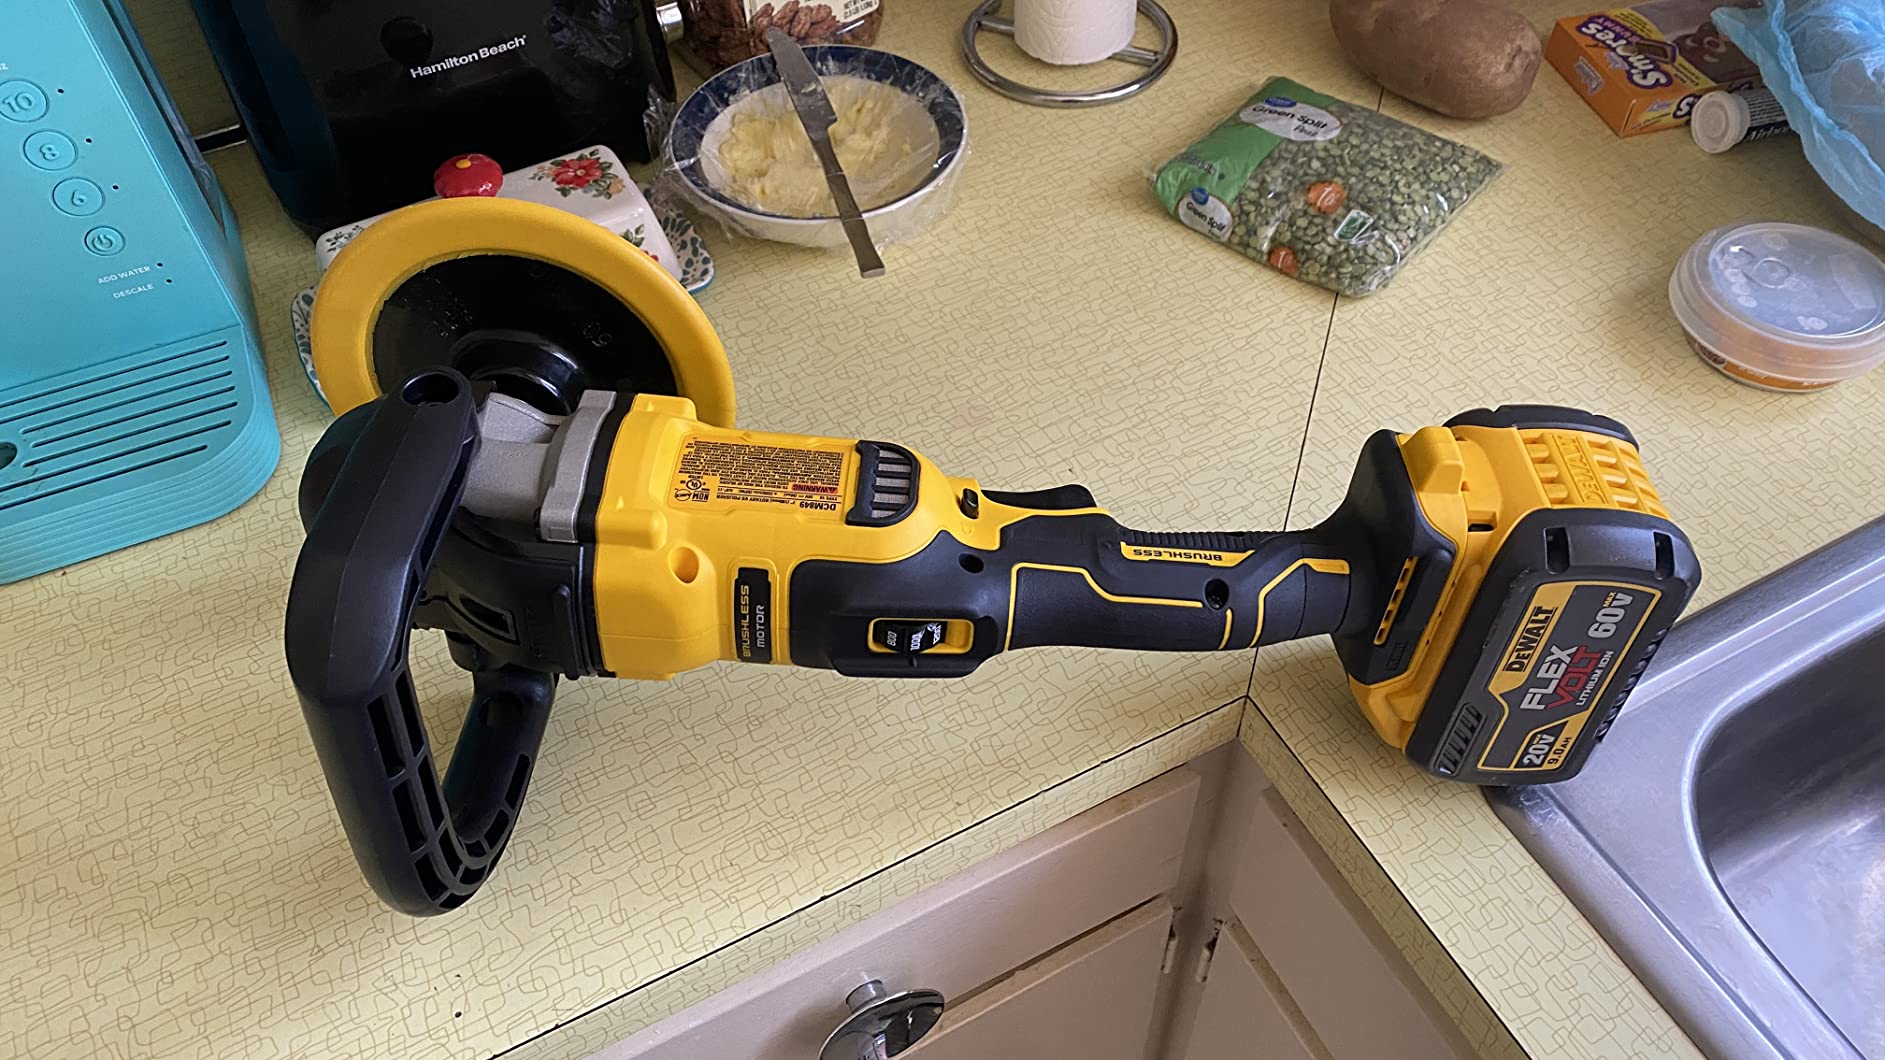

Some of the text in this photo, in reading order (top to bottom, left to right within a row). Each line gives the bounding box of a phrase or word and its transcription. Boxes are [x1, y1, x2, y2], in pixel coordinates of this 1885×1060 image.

[410, 36, 526, 78] Hamilton Beach
[2, 92, 34, 113] 10
[1252, 105, 1328, 130] Green Split
[39, 144, 60, 161] 8
[71, 189, 88, 207] 6
[1186, 201, 1208, 222] Green
[98, 265, 151, 284] ADD WATER
[113, 283, 154, 299] DESCALE
[792, 484, 829, 493] WARNING
[799, 501, 837, 511] DCM849
[1133, 548, 1223, 562] BRUSHLESS
[1603, 591, 1617, 608] MAX
[741, 584, 751, 657] BRUSHLESS
[755, 604, 765, 648] MOTOR
[1588, 592, 1633, 639] 60V
[1504, 606, 1556, 672] DEWALT
[1520, 645, 1578, 710] FLEX
[1546, 645, 1606, 710] VOLT
[1575, 650, 1615, 706] LITHIUM ION
[1522, 734, 1555, 766] 20V
